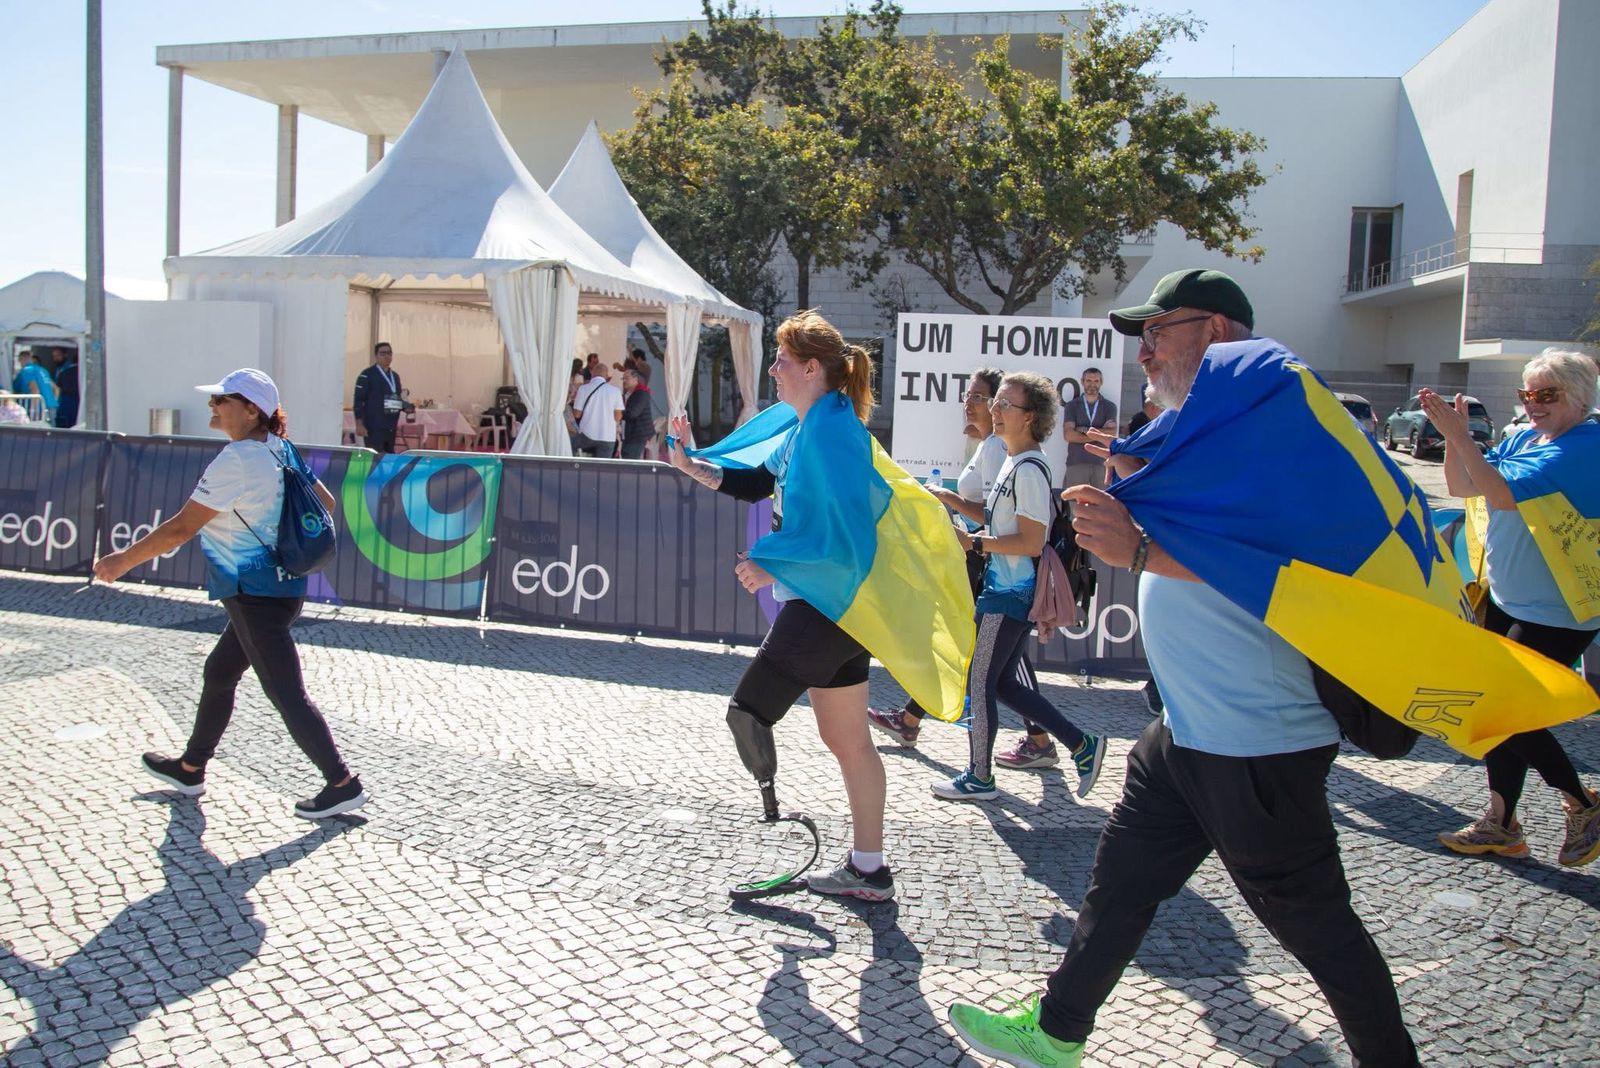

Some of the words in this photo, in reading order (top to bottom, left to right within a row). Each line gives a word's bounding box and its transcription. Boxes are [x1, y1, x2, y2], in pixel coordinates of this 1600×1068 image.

[903, 322, 953, 353] UM
[981, 324, 1113, 359] HOMEM
[900, 371, 1081, 407] INTO
[896, 459, 927, 467] entrada
[931, 459, 953, 467] livre
[0, 500, 78, 561] edp
[110, 509, 182, 571] ed
[511, 544, 610, 614] edp
